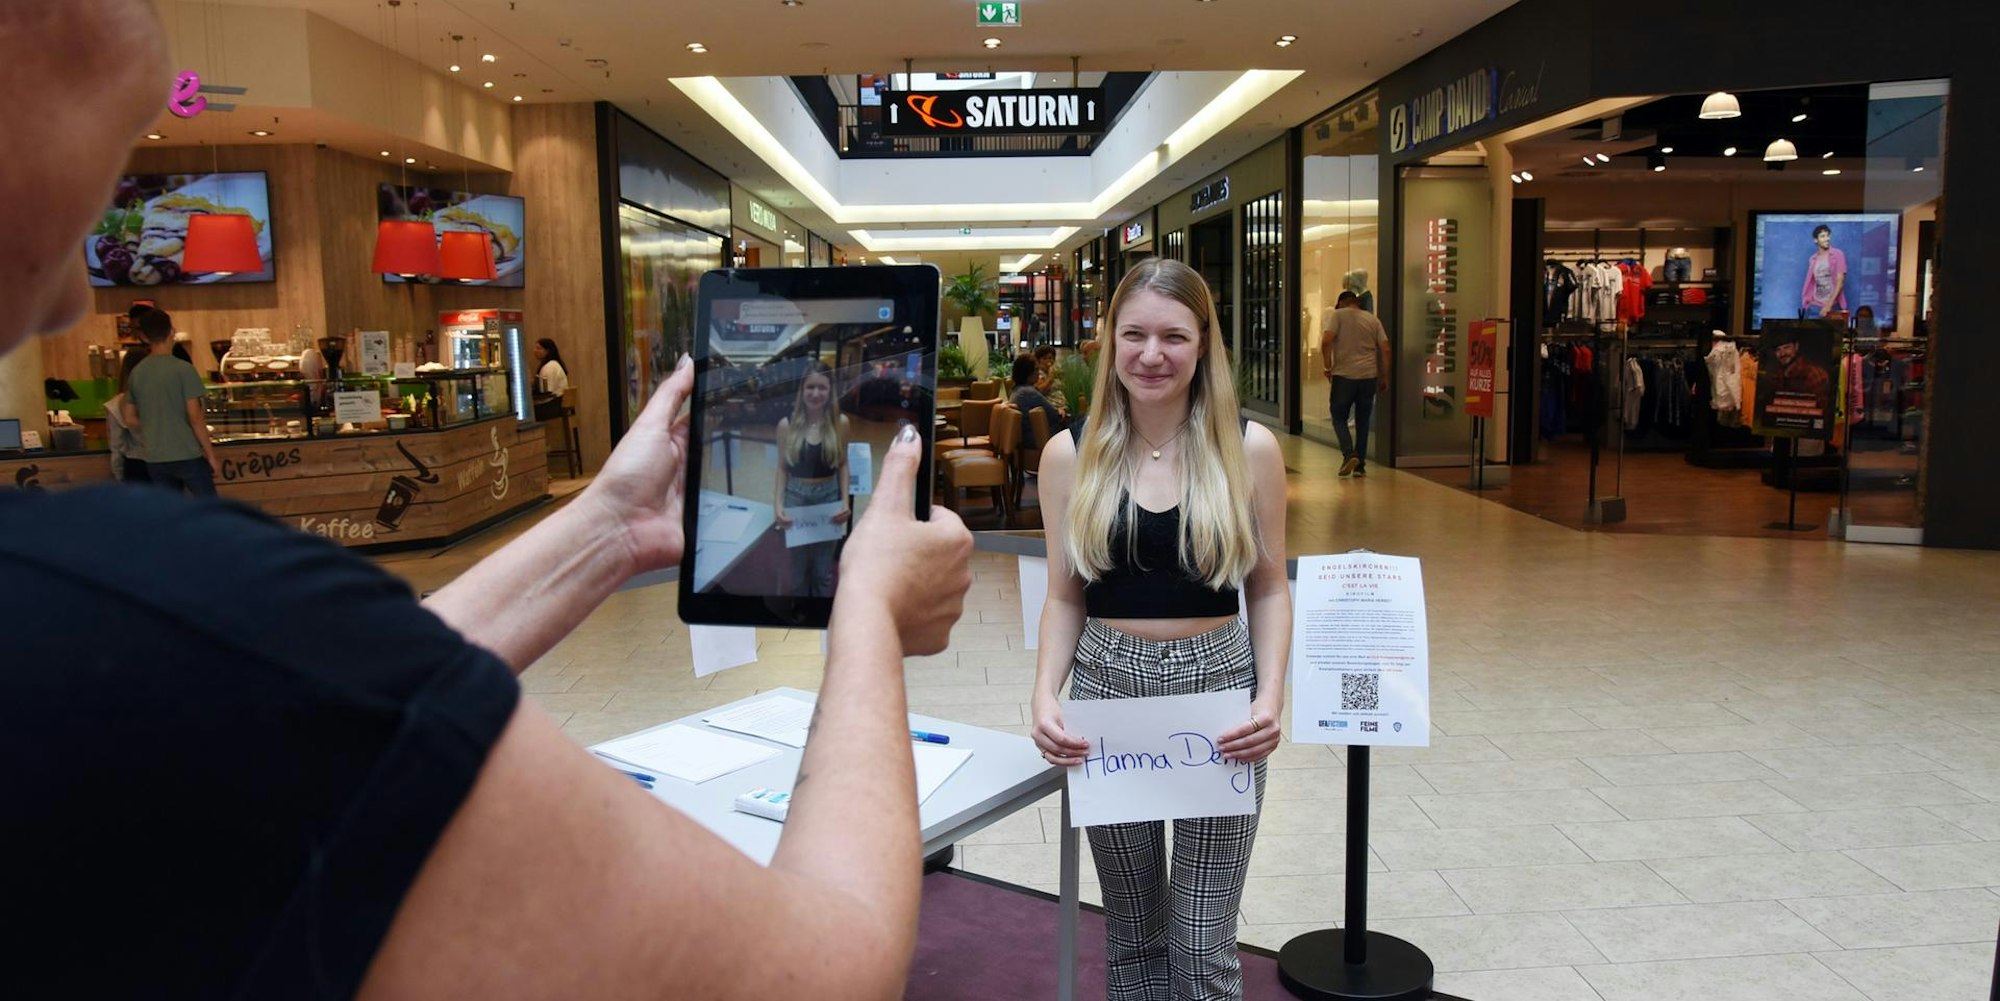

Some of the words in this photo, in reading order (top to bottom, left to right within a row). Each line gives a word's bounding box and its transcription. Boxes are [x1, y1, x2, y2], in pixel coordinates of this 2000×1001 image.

[965, 94, 1079, 128] SATURN
[1412, 87, 1444, 145] CAMP
[1447, 67, 1488, 134] DAVID
[222, 448, 301, 481] Crêpes
[300, 517, 375, 539] Kaffee
[1083, 736, 1173, 780] Hanna
